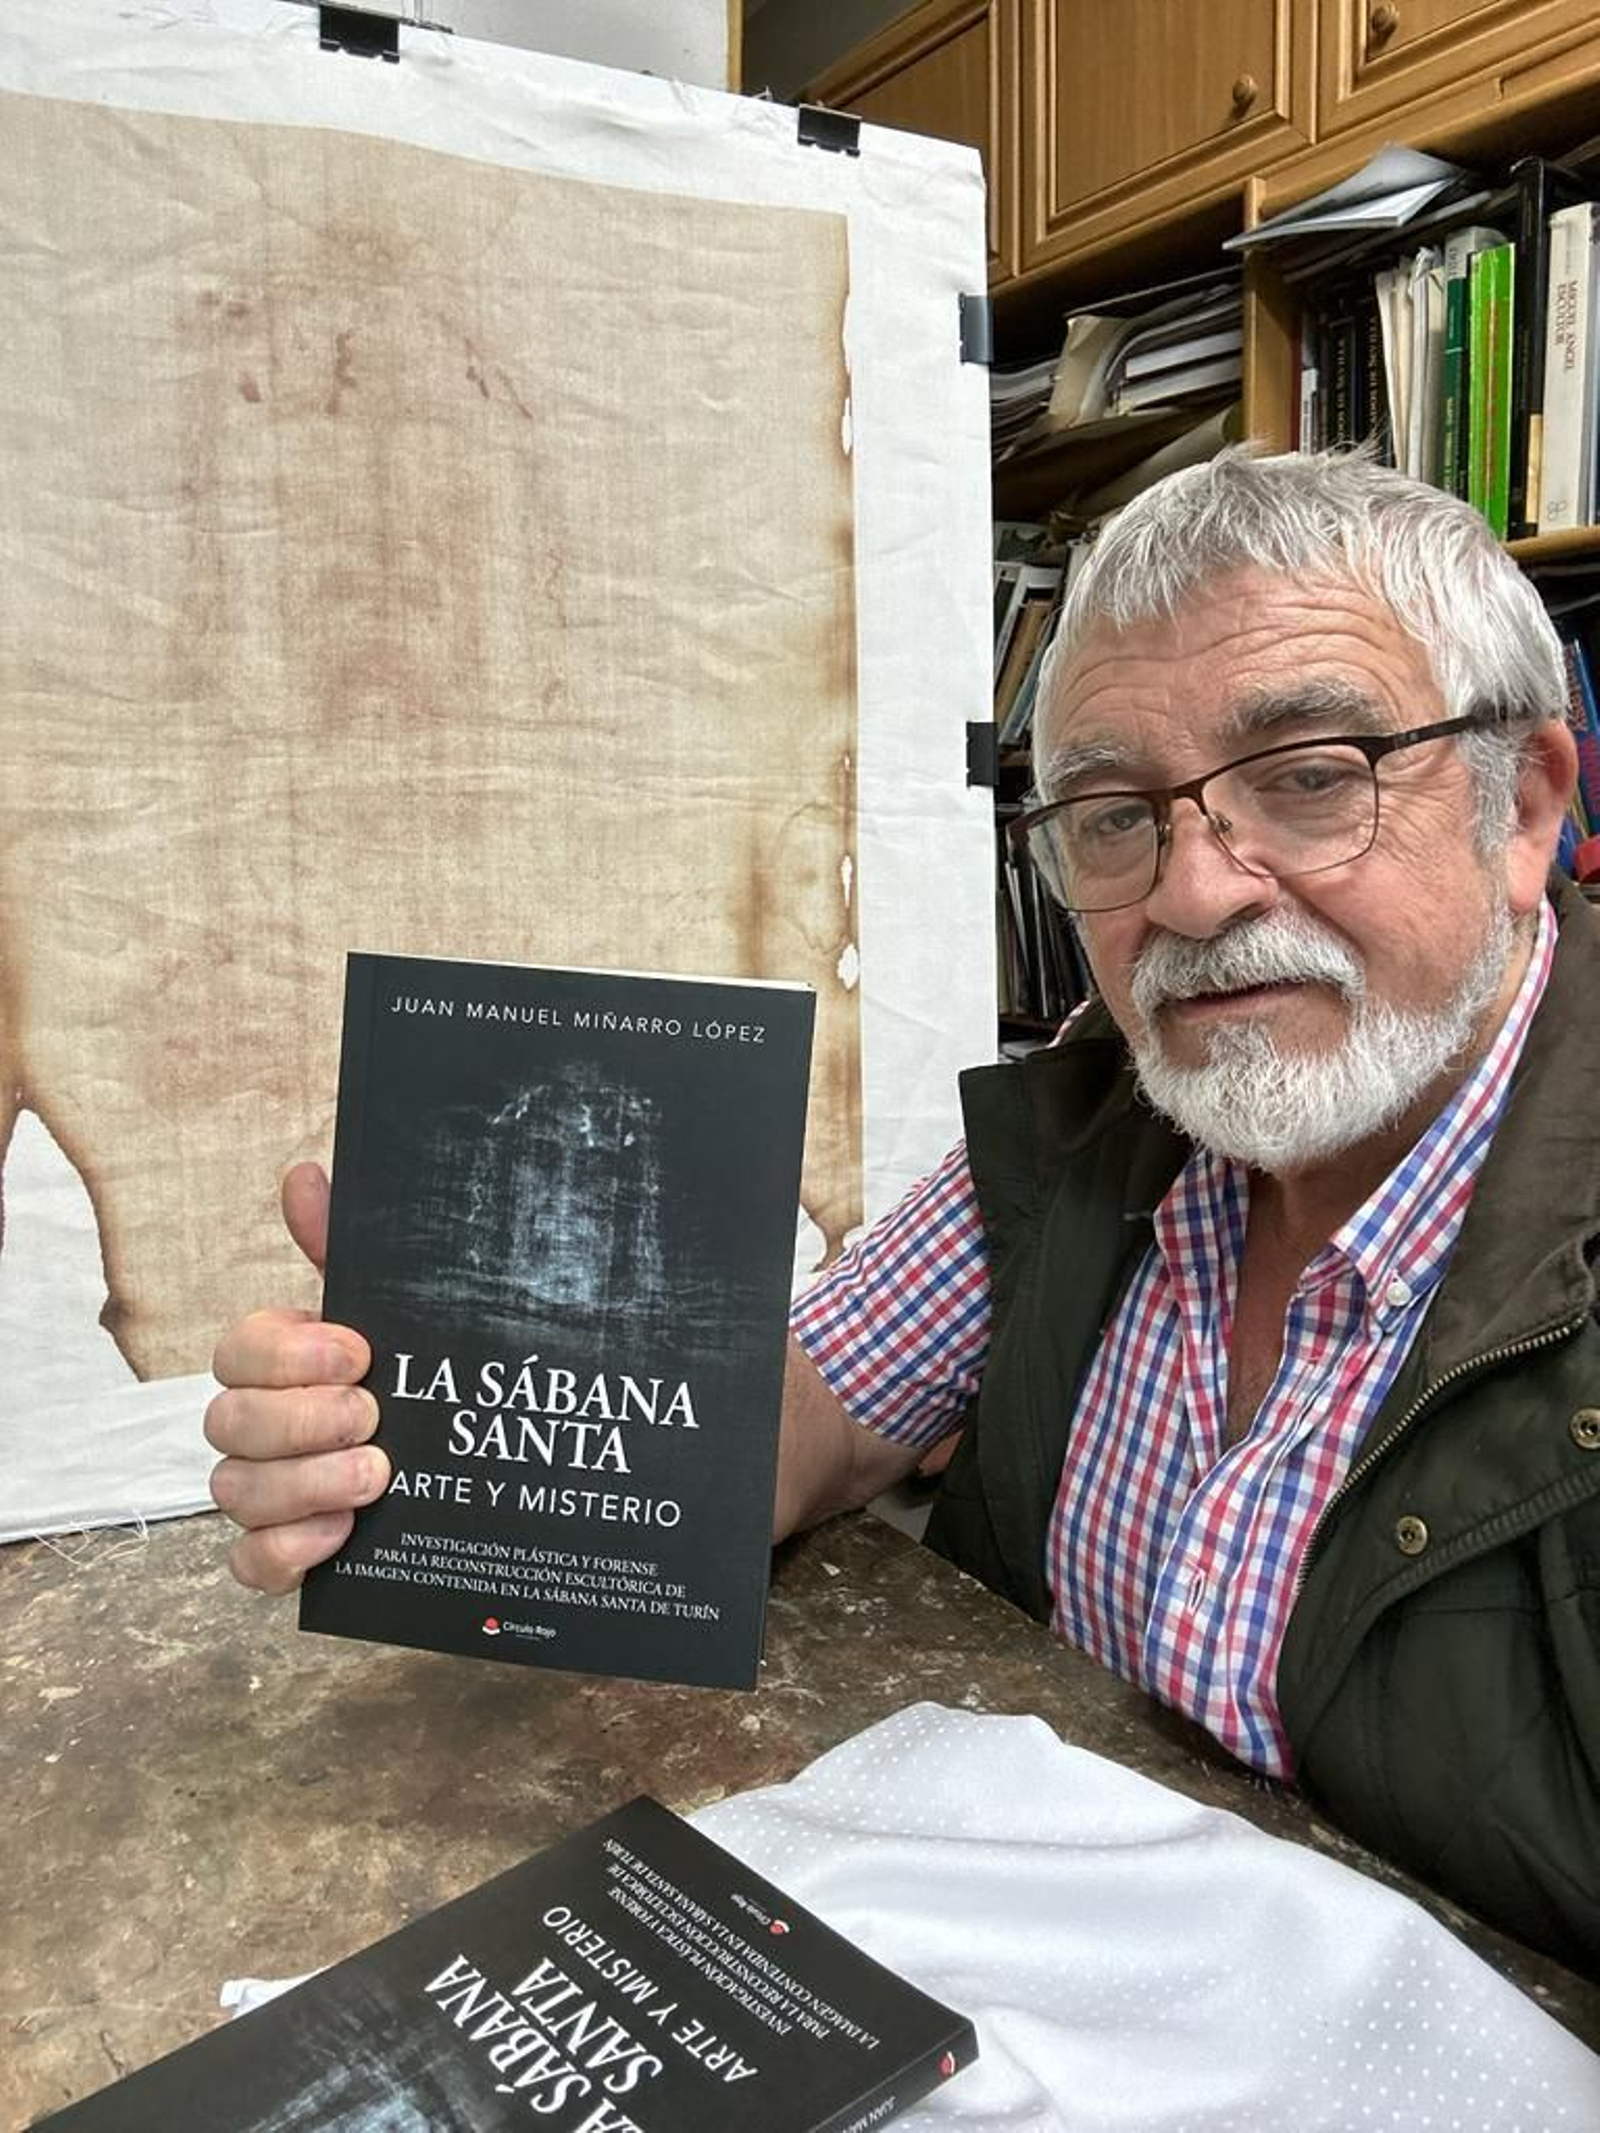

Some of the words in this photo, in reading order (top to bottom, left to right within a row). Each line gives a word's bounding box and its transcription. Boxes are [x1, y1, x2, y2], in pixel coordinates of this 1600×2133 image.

[391, 996, 454, 1017] JUAN
[466, 1002, 562, 1026] MANUEL
[573, 1010, 681, 1036] MIÑARRO
[692, 1019, 766, 1043] LÓPEZ
[391, 1353, 461, 1403] LA
[476, 1354, 700, 1429] SÁBANA
[448, 1409, 632, 1474] SANTA
[388, 1470, 473, 1504] ARTE
[486, 1480, 506, 1507] Y
[518, 1484, 681, 1528] MISTERIO
[374, 1548, 408, 1564] PARA
[411, 1552, 428, 1567] LA
[431, 1554, 563, 1584] RECONSTRUCCIÓN
[565, 1571, 662, 1596] ESCULTÓRICA
[665, 1583, 686, 1599] DE
[401, 1532, 511, 1559] INVESTIGACIÓN
[513, 1546, 578, 1567] PLÁSTICA
[582, 1554, 592, 1569] Y
[593, 1556, 658, 1578] FORENSE
[335, 1561, 352, 1575] LA
[355, 1563, 411, 1582] IMAGEN
[413, 1571, 498, 1595] CONTENIDA
[500, 1582, 521, 1597] EN
[523, 1585, 541, 1600] LA
[543, 1586, 598, 1608] SÁBANA
[600, 1594, 647, 1614] SANTA
[650, 1600, 671, 1616] DE
[673, 1602, 720, 1621] TURÍN
[542, 1905, 660, 2005] MISTERIO
[741, 1945, 812, 2002] CONTENIDA
[511, 1957, 664, 2094] SANTA
[646, 2002, 678, 2026] Y
[700, 1962, 793, 2037] INVESTIGACIÓN
[797, 2011, 830, 2039] PARA
[807, 1998, 862, 2038] IMAGEN
[424, 1954, 592, 2114] SÁBANA
[671, 2018, 759, 2084] ARTE
[859, 2031, 880, 2050] LA
